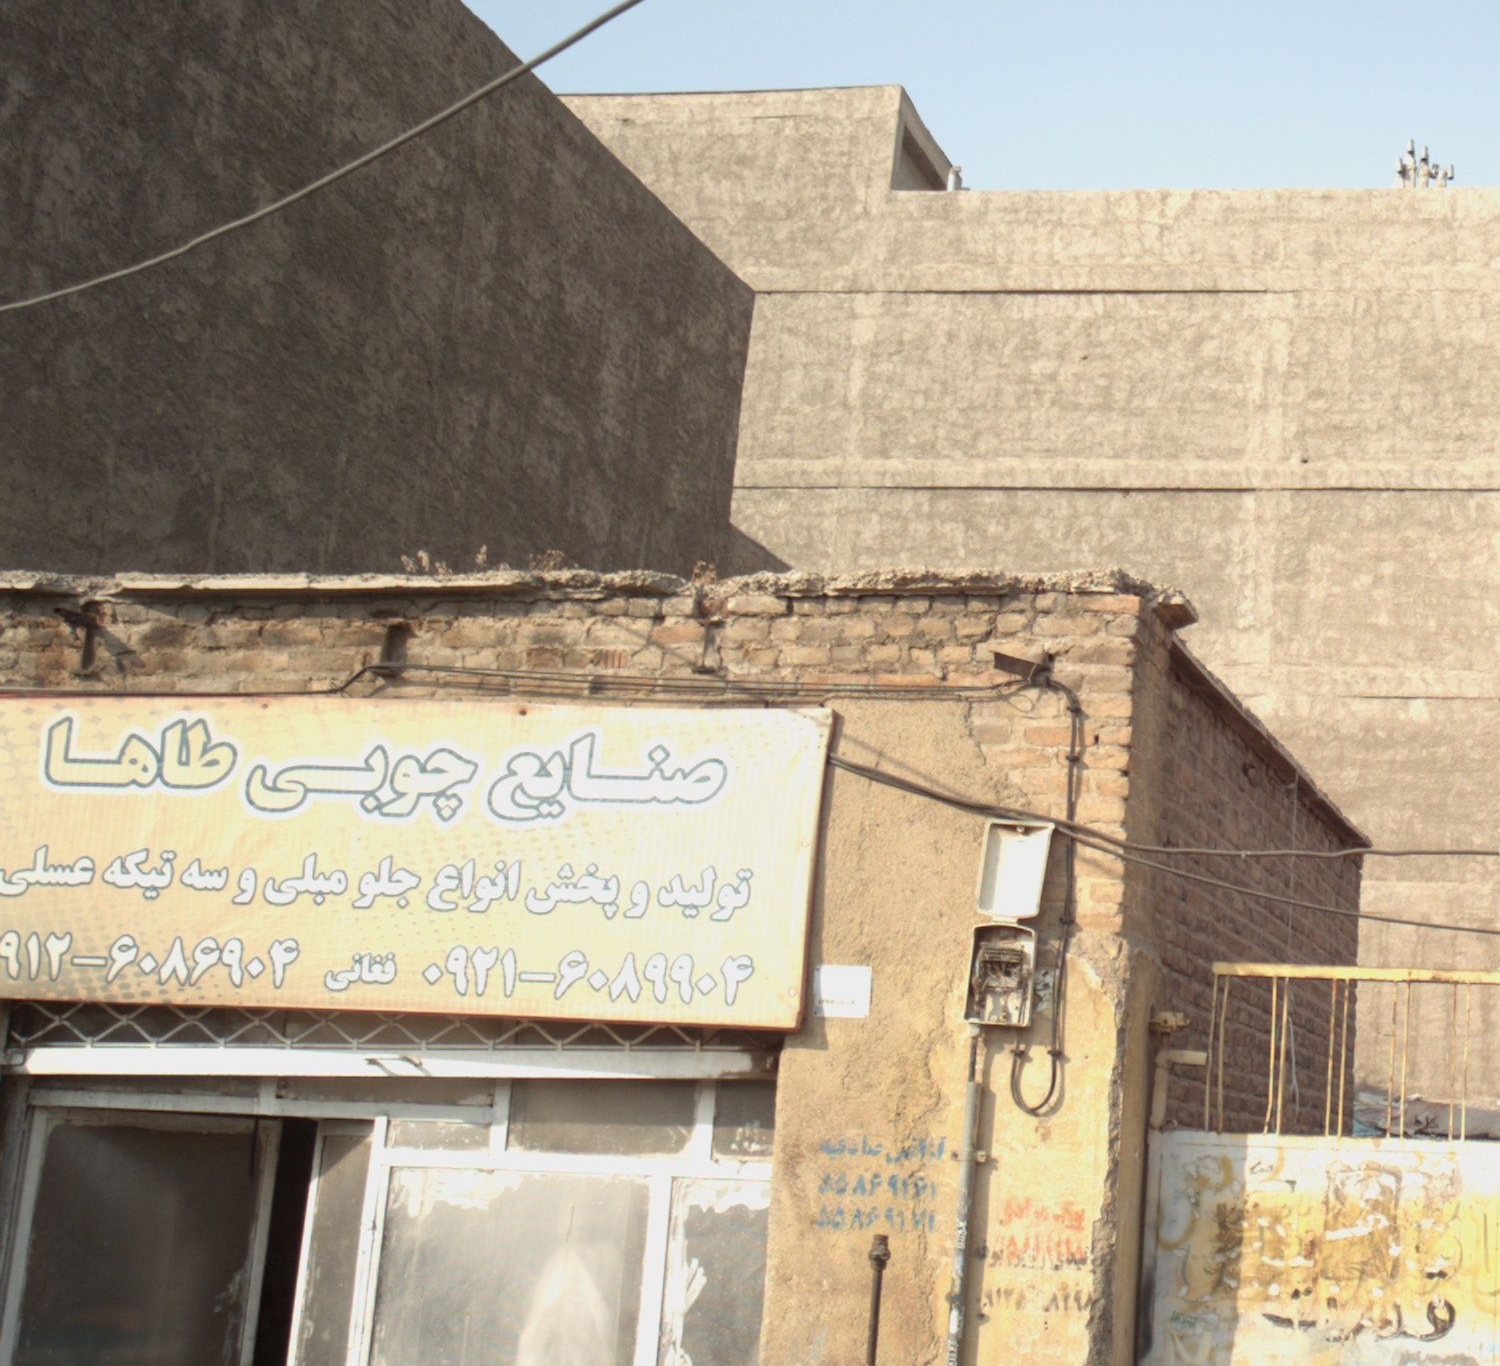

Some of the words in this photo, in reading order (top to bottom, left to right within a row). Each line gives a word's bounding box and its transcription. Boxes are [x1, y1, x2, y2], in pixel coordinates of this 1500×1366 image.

[44, 716, 238, 788] طاها
[487, 731, 728, 821] صنایع
[245, 743, 479, 822] چوبی
[0, 844, 96, 897] عسلی
[102, 848, 177, 901] تیکه
[180, 858, 229, 891] سه
[232, 867, 257, 905] و
[263, 852, 349, 906] مبلی
[352, 855, 421, 909] جلو
[426, 858, 522, 912] انواع
[524, 863, 620, 920] پخش
[657, 865, 754, 921] تولید
[623, 881, 650, 918] و
